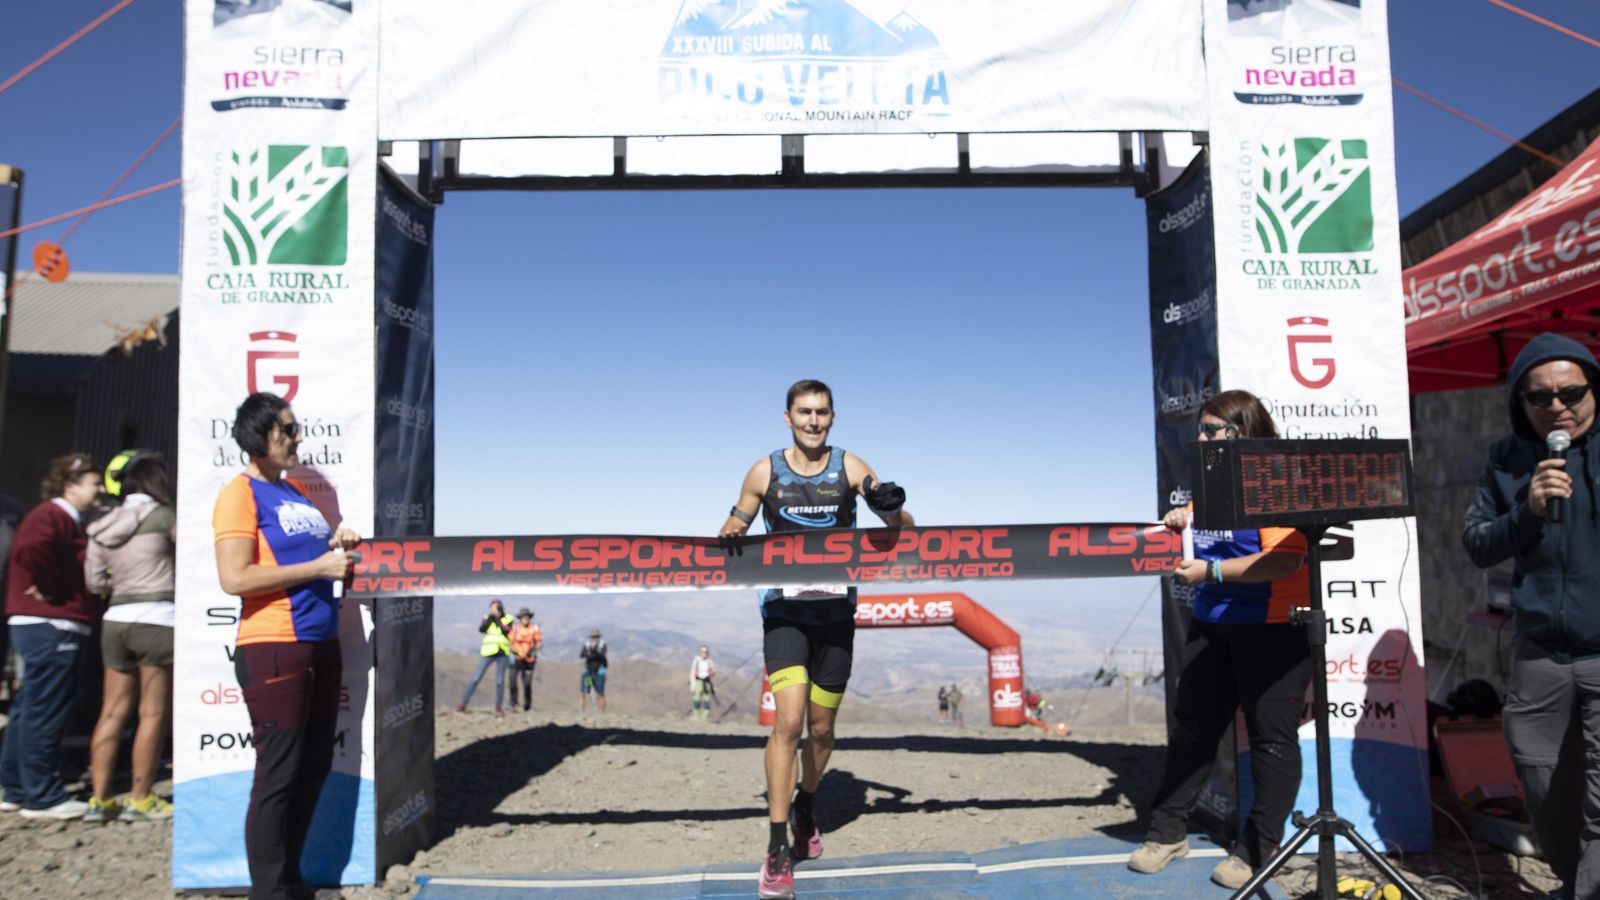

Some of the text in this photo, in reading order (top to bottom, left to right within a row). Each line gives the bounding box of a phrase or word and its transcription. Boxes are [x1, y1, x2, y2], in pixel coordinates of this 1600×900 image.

[254, 42, 344, 66] sierra
[673, 34, 832, 54] XXXVIII SUBIDA AL
[1271, 41, 1356, 65] sierra
[783, 63, 951, 106] VEA
[1246, 65, 1356, 87] nevada
[806, 110, 876, 122] MOUNTAIN
[1242, 258, 1378, 277] CAJA RURAL
[207, 272, 350, 290] CAJA RURAL
[1258, 278, 1362, 291] DE GRANADA
[221, 292, 334, 304] DE GRANADA
[213, 444, 343, 467] de Gada
[762, 528, 1013, 565] ALS SPORT
[1048, 526, 1138, 557] ALS
[354, 542, 435, 574] ORT
[472, 538, 726, 571] ALS SPORT
[555, 570, 727, 588] VISTE TU EVENTO
[846, 562, 1014, 581] VISTE TU EVENTO
[352, 576, 435, 592] EVENTO
[1327, 580, 1387, 598] AT
[853, 597, 954, 626] sport.es
[1326, 653, 1401, 677] ort.es
[993, 683, 1023, 708] als
[1301, 701, 1396, 720] RGYM
